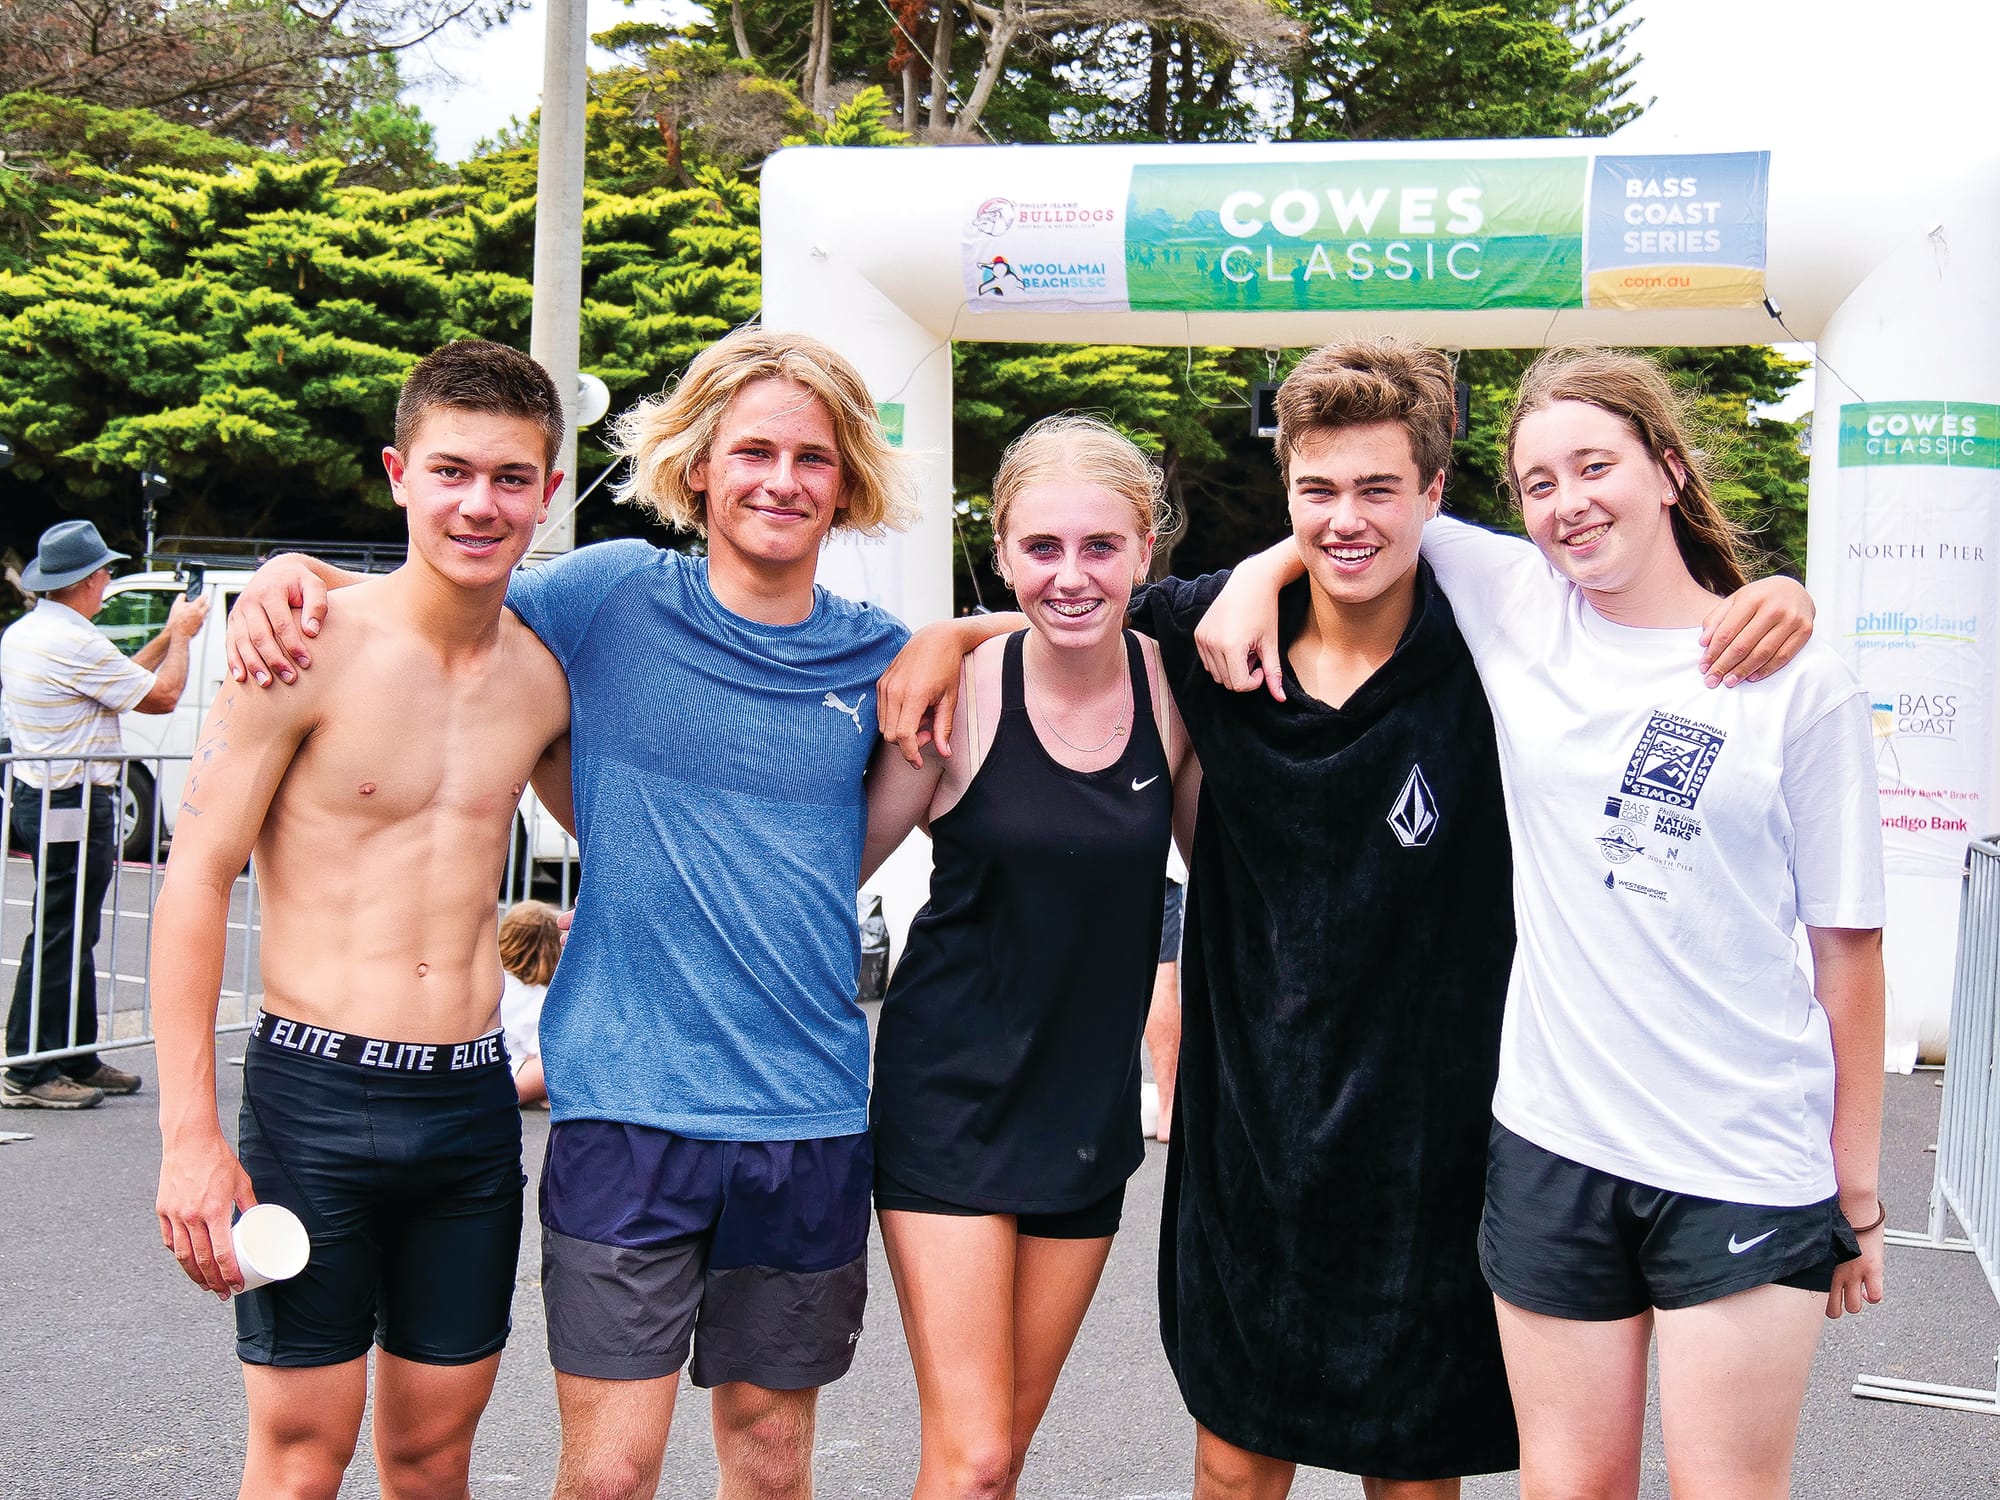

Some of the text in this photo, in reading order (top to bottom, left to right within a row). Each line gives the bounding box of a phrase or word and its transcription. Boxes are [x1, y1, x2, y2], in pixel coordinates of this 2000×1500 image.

[1625, 177, 1697, 198] BASS
[1019, 209, 1114, 222] BULLDOGS
[1219, 186, 1485, 238] COWES
[1623, 202, 1721, 225] COAST
[1623, 229, 1721, 254] SERIES
[1019, 263, 1105, 275] WOOLAMAI
[1220, 241, 1483, 283] CLASSIC
[1619, 276, 1690, 288] .com.au
[1866, 413, 1977, 437] COWES
[1866, 437, 1975, 456] CLASSIC
[1848, 543, 1985, 562] NORTH PIER
[1855, 640, 1916, 650] nature parks
[1898, 694, 1957, 718] BASS
[1650, 718, 1712, 744] COWES
[1653, 709, 1669, 718] THE
[1692, 721, 1728, 738] ANNUAL
[1898, 718, 1956, 735] COAST
[1624, 729, 1655, 787] CLASSIC
[1686, 742, 1720, 798] CLASSIC
[1631, 784, 1692, 807] COWES
[1621, 810, 1648, 823] COAST
[1622, 800, 1650, 816] BASS
[1658, 807, 1680, 820] Phillip
[1653, 823, 1692, 841] PARKS
[1655, 814, 1702, 837] NATURE
[1931, 816, 1968, 832] Bank
[1647, 854, 1674, 867] NORTH
[1676, 862, 1693, 872] PIER
[270, 1018, 347, 1059] ELITE
[360, 1040, 437, 1071] ELITE
[450, 1038, 500, 1070] ELITE
